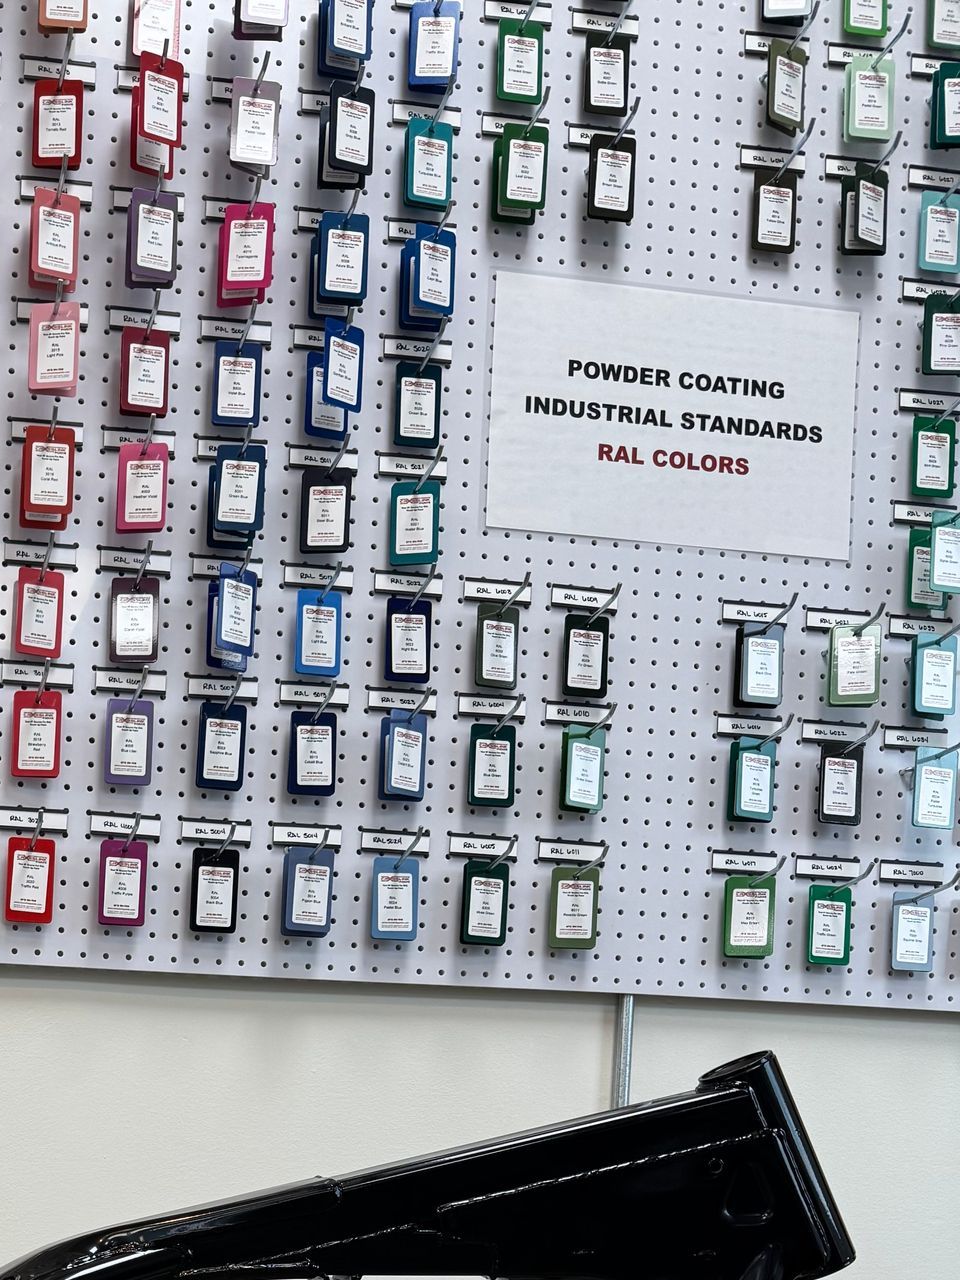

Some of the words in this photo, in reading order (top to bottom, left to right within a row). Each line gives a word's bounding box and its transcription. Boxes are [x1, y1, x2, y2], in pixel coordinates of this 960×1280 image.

[398, 227, 414, 235] RAL
[123, 315, 137, 323] RAL
[568, 359, 671, 388] POWDER
[679, 371, 785, 400] COATING
[524, 395, 673, 428] INDUSTRIAL
[681, 412, 823, 444] STANDARDS
[598, 444, 644, 465] RAL
[653, 450, 749, 476] COLORS
